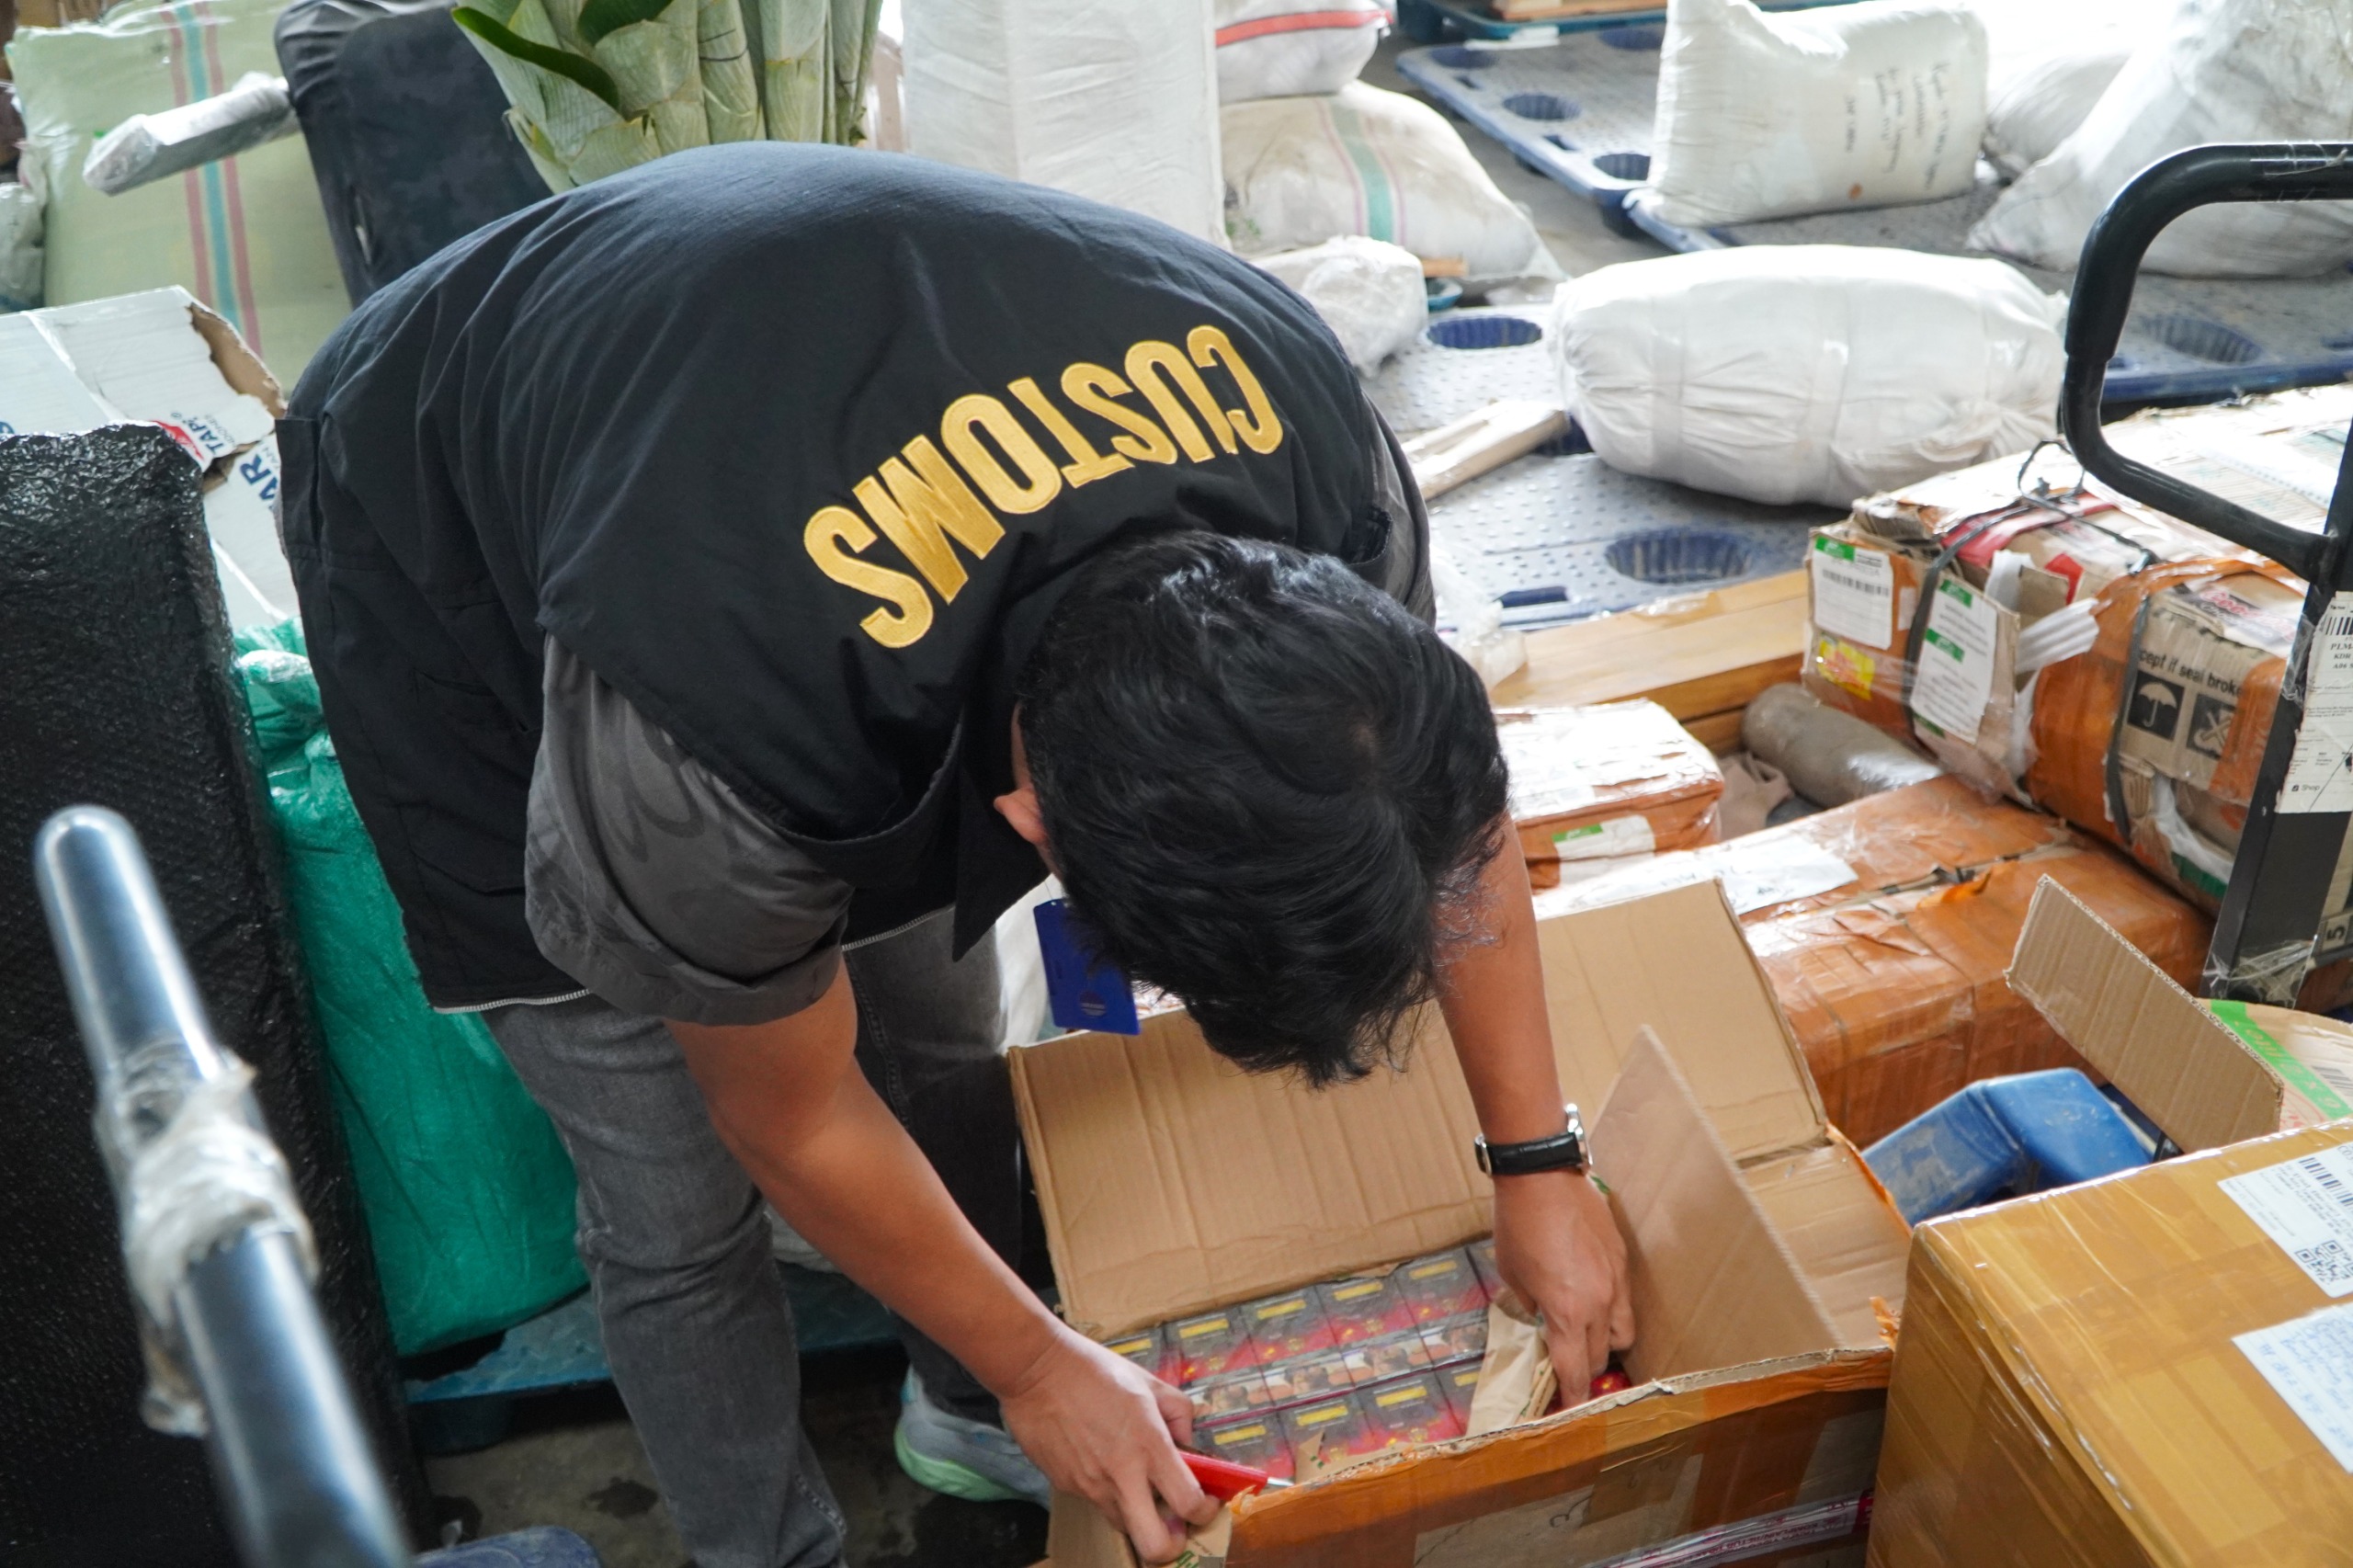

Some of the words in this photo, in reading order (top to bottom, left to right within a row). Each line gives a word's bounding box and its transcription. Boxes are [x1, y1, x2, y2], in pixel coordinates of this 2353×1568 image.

[188, 416, 224, 455] TAP
[240, 453, 278, 511] AR
[804, 325, 1283, 649] CUSTOMS
[2140, 650, 2165, 668] cept
[2168, 657, 2178, 674] if
[2179, 665, 2205, 682] seal
[2208, 672, 2242, 696] broke
